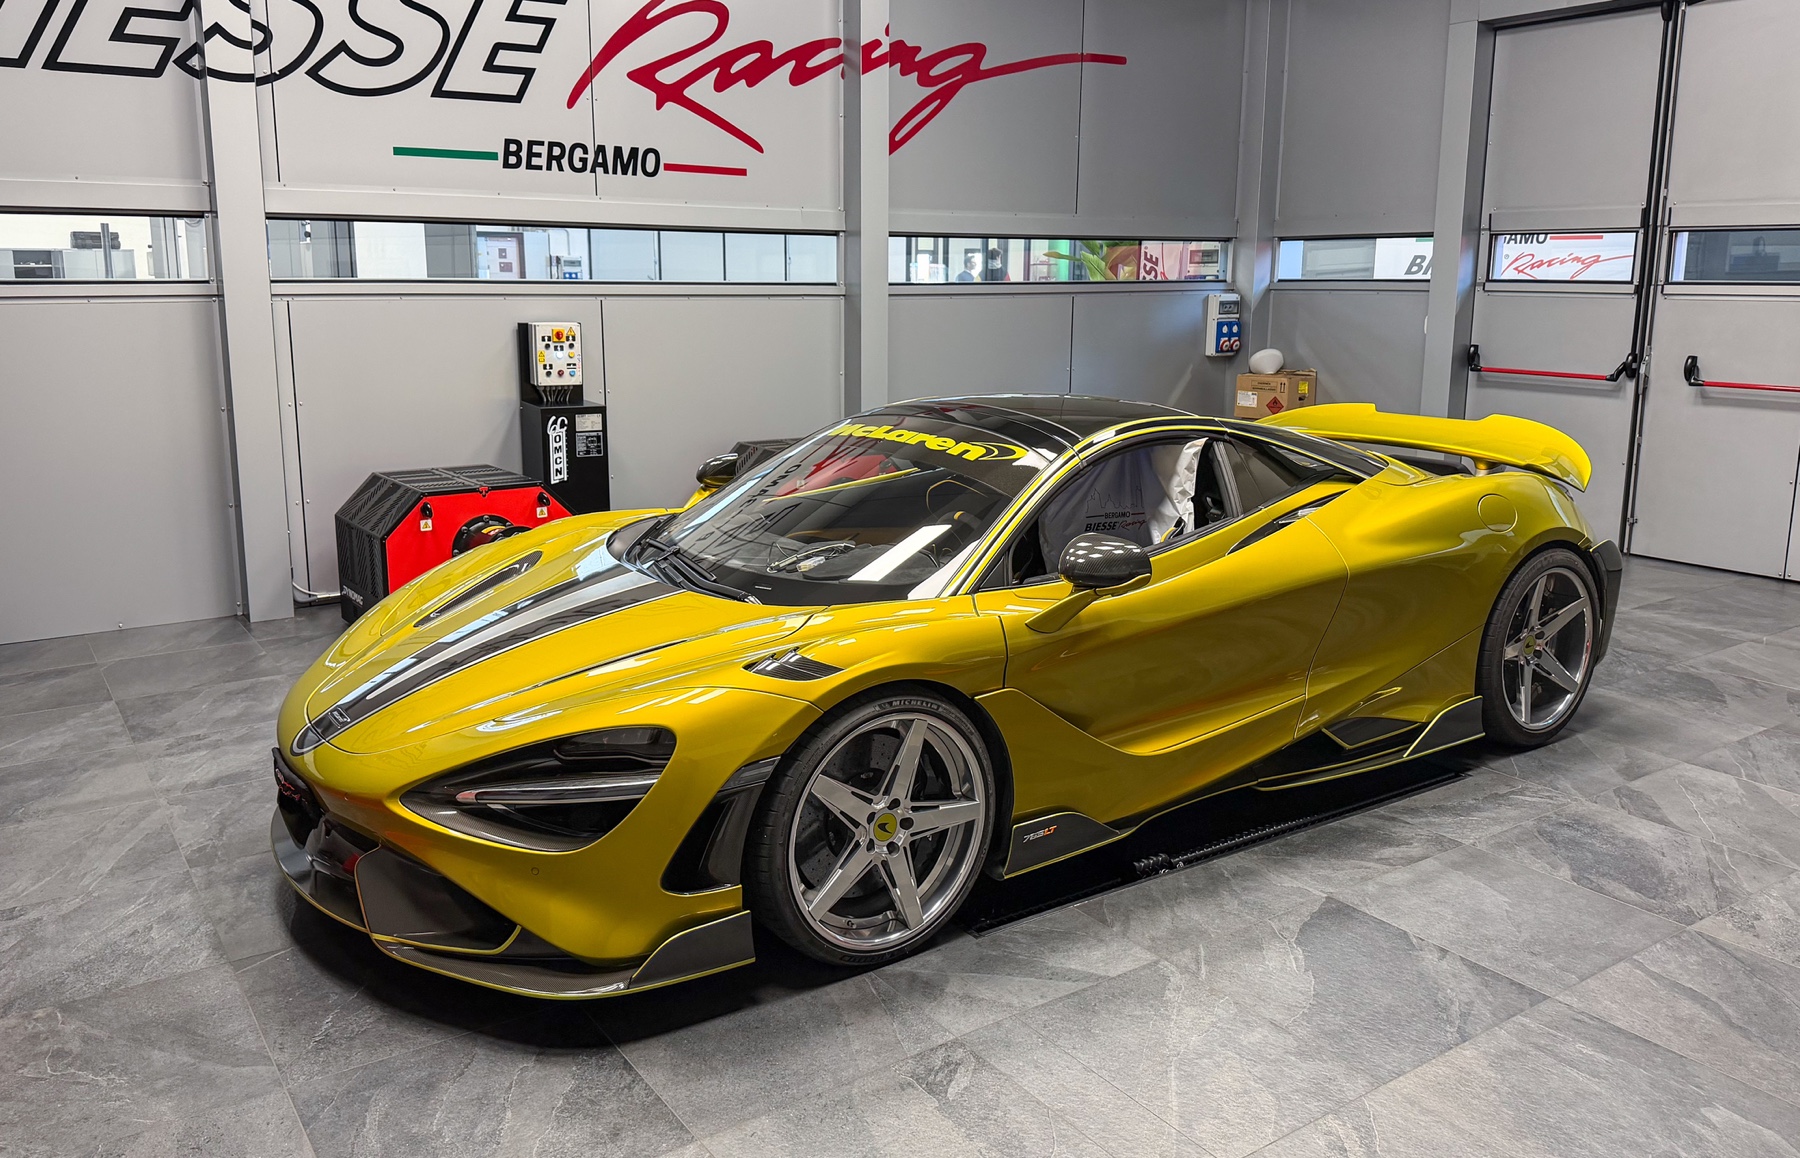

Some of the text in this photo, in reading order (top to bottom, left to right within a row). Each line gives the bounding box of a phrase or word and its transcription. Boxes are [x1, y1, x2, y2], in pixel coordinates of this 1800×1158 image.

[502, 138, 661, 178] BERGAMO
[1501, 251, 1634, 280] Racing
[828, 423, 988, 462] McLaren
[1104, 511, 1131, 519] BERGAMO
[1084, 521, 1117, 532] BIESSE
[892, 700, 939, 711] MICHELIN
